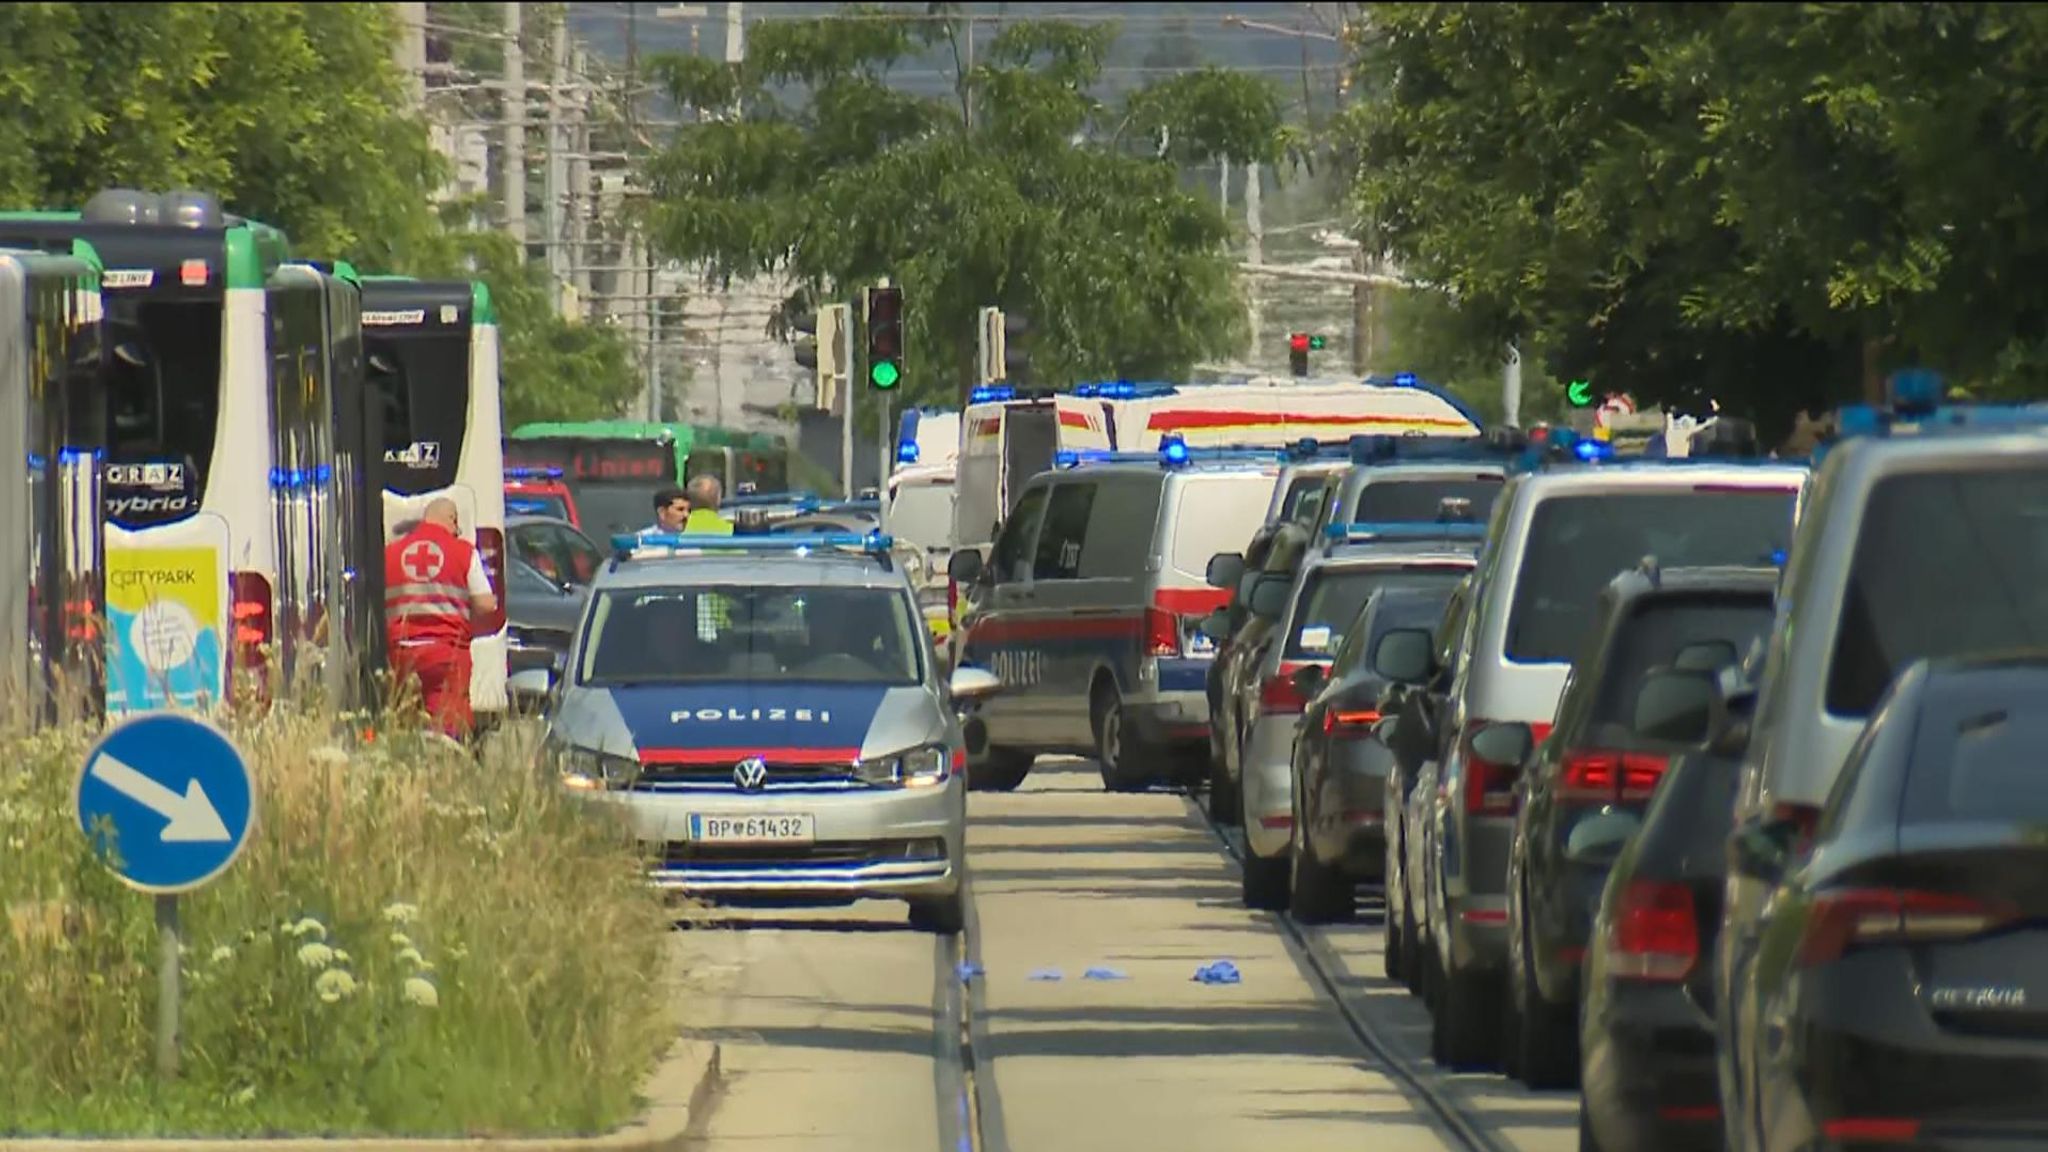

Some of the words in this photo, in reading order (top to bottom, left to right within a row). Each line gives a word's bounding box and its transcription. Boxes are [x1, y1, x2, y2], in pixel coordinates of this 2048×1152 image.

[106, 463, 184, 484] GRAZ
[574, 452, 662, 478] Linien
[670, 708, 830, 723] POLIZEI
[708, 819, 731, 837] BP
[746, 819, 802, 838] 61432
